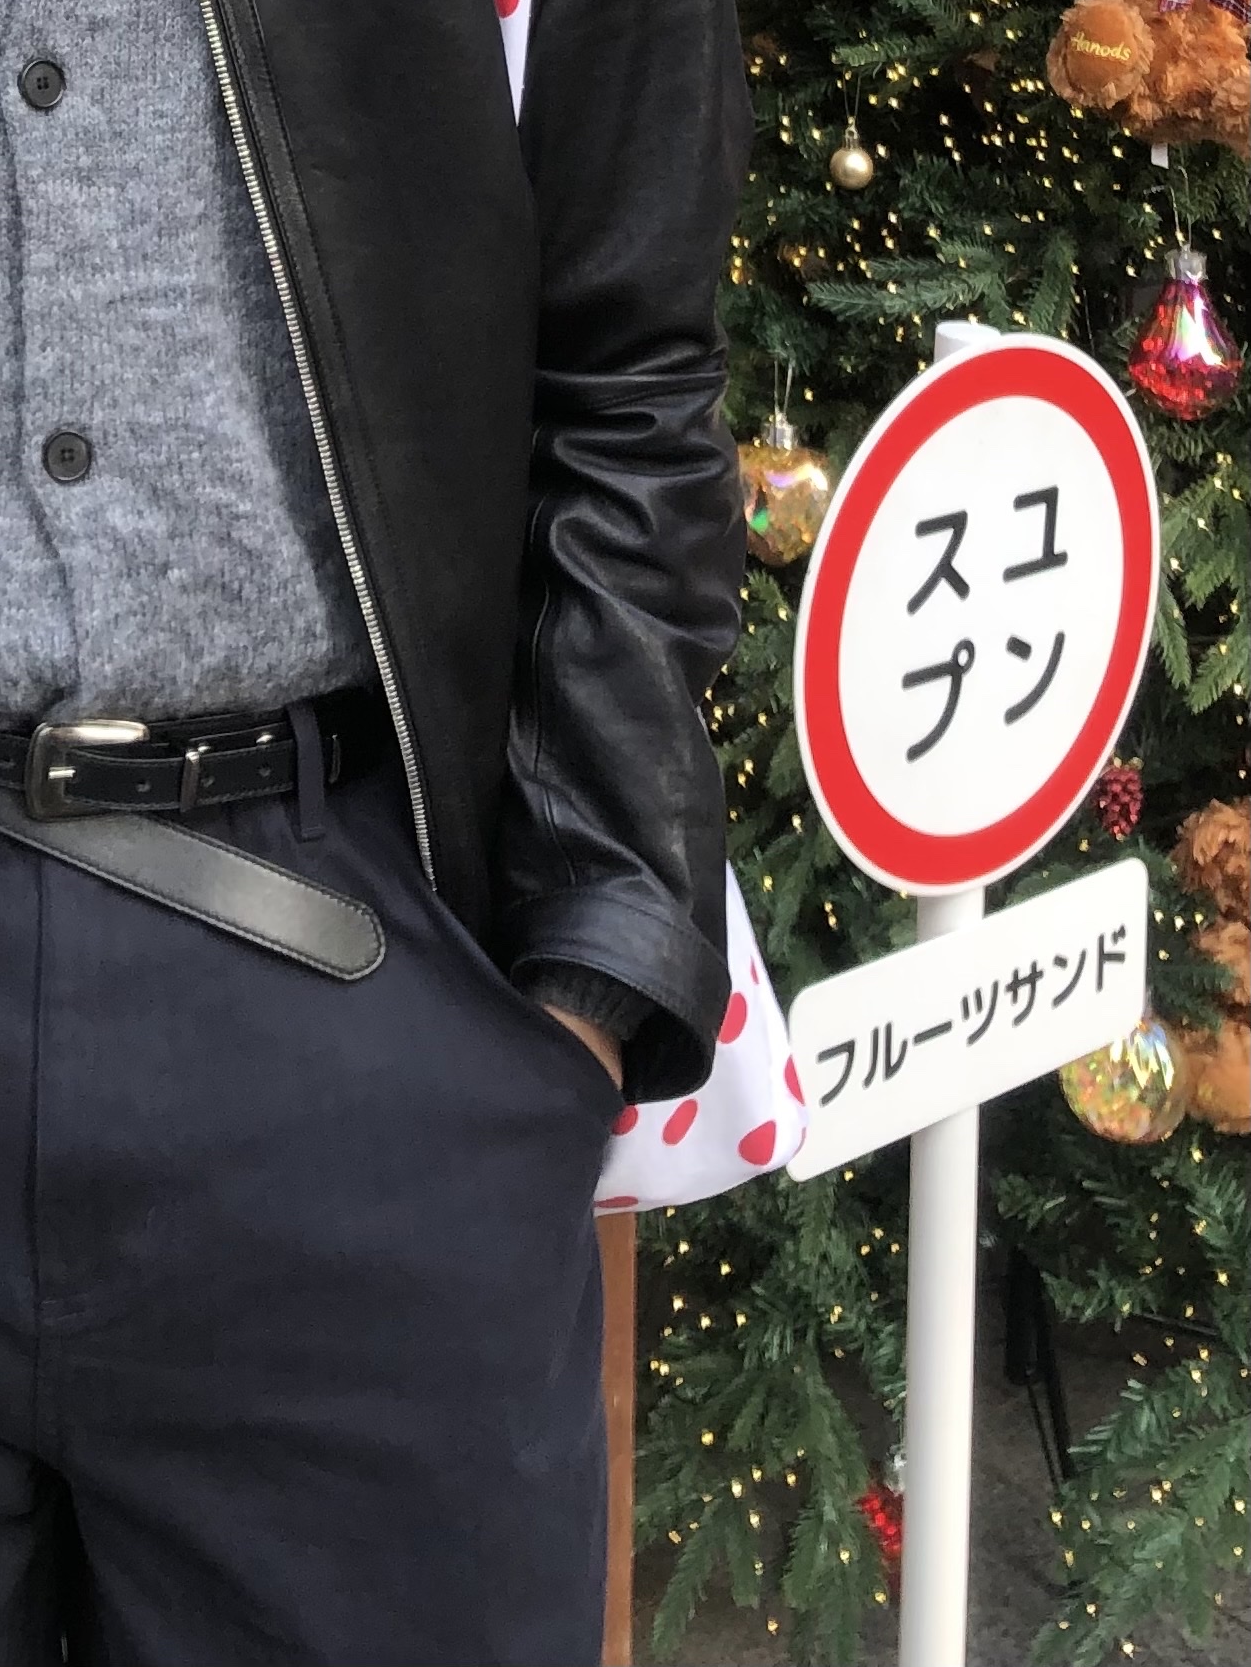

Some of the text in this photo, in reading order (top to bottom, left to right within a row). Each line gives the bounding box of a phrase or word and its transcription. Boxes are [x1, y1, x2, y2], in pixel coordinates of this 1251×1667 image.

[816, 924, 1127, 1109] フルーツサンド
